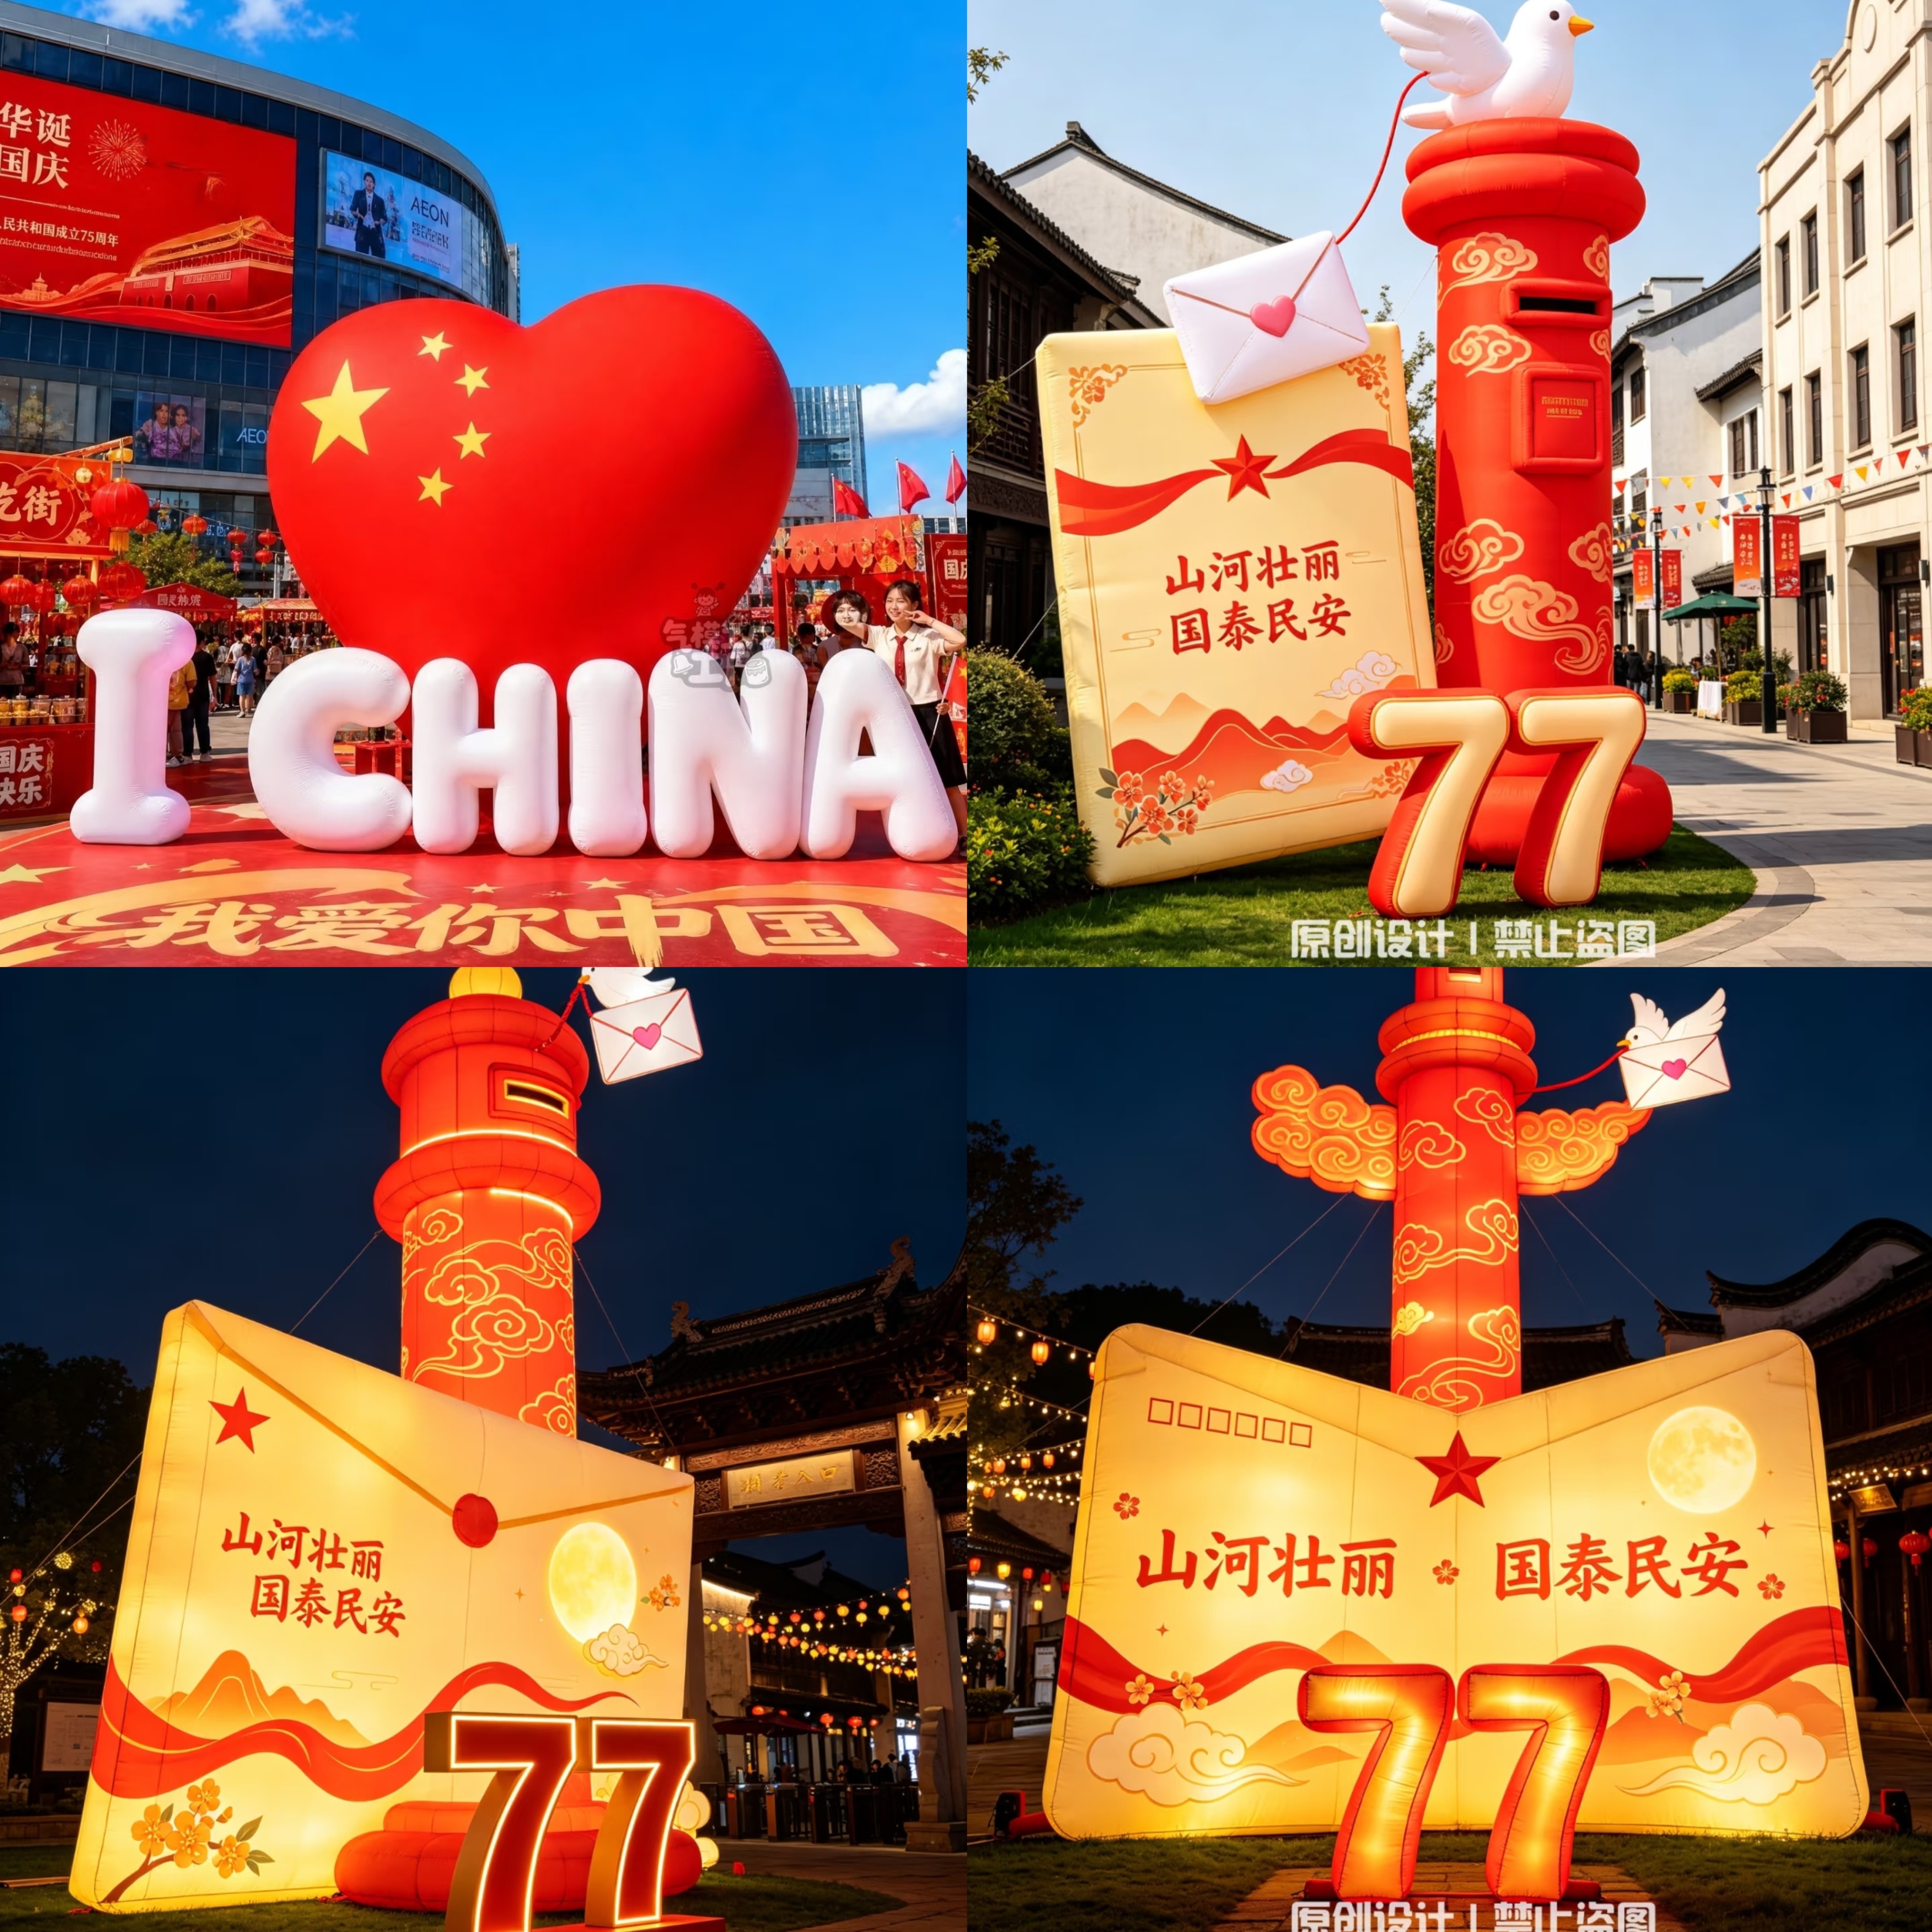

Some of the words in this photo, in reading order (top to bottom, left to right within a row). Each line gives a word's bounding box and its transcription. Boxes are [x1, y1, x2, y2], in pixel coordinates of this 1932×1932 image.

[0, 101, 71, 148] 华诞
[0, 144, 69, 189] 国庆
[0, 217, 119, 248] 民共和国成立75周年
[410, 197, 449, 227] AEON
[236, 427, 268, 444] AEO
[1166, 540, 1340, 595] 山河壮丽
[1170, 593, 1351, 655] 国泰民安
[70, 608, 197, 845] I
[248, 647, 958, 862] CHINA
[1348, 685, 1647, 919] 77
[125, 894, 899, 966] 我爱你中国
[221, 1512, 384, 1582] 山河壮丽
[1136, 1529, 1397, 1599] 山河壮丽
[1496, 1532, 1749, 1602] 国泰民安
[250, 1574, 406, 1638] 国泰民安
[1297, 1664, 1610, 1904] 77
[425, 1711, 696, 1932] 77
